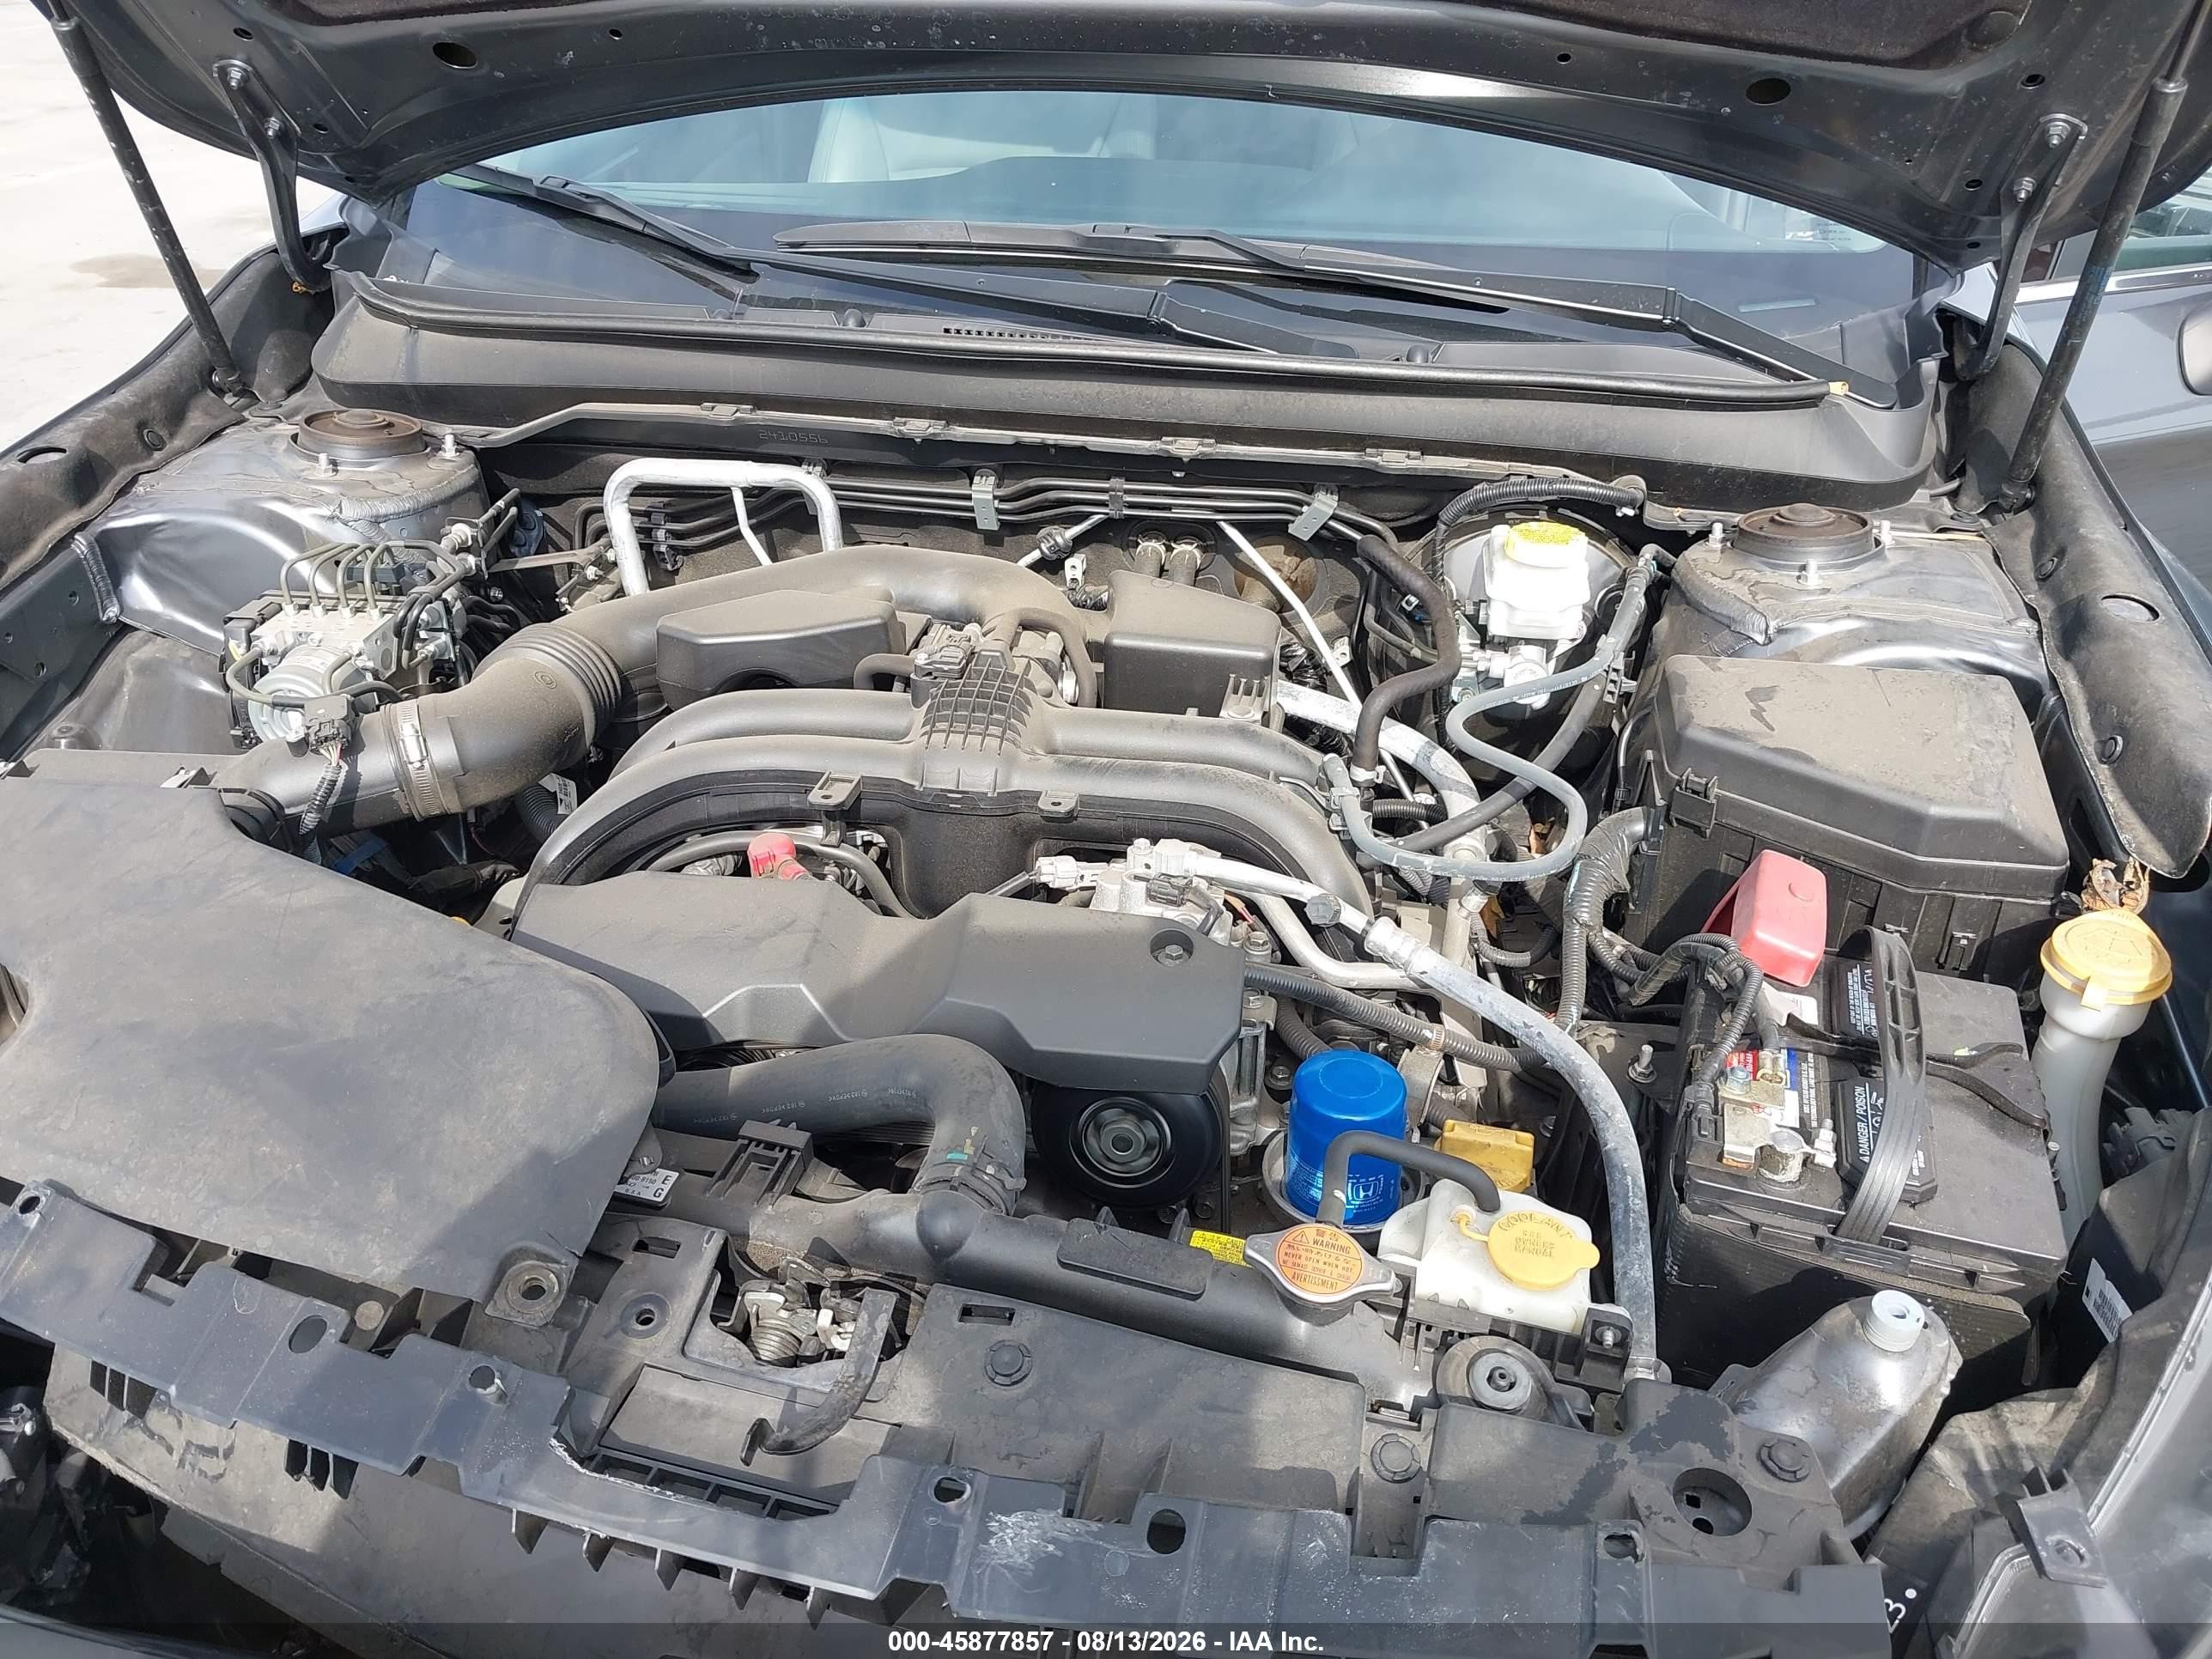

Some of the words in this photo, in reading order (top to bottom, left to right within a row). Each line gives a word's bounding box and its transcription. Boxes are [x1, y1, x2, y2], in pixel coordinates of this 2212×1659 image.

[1855, 1086, 1867, 1115] POISON
[1857, 1121, 1870, 1155] DANGER
[662, 1175, 672, 1185] E
[653, 1188, 664, 1198] G
[1498, 1212, 1573, 1240] COOLANT
[1312, 1237, 1351, 1255] WARNING
